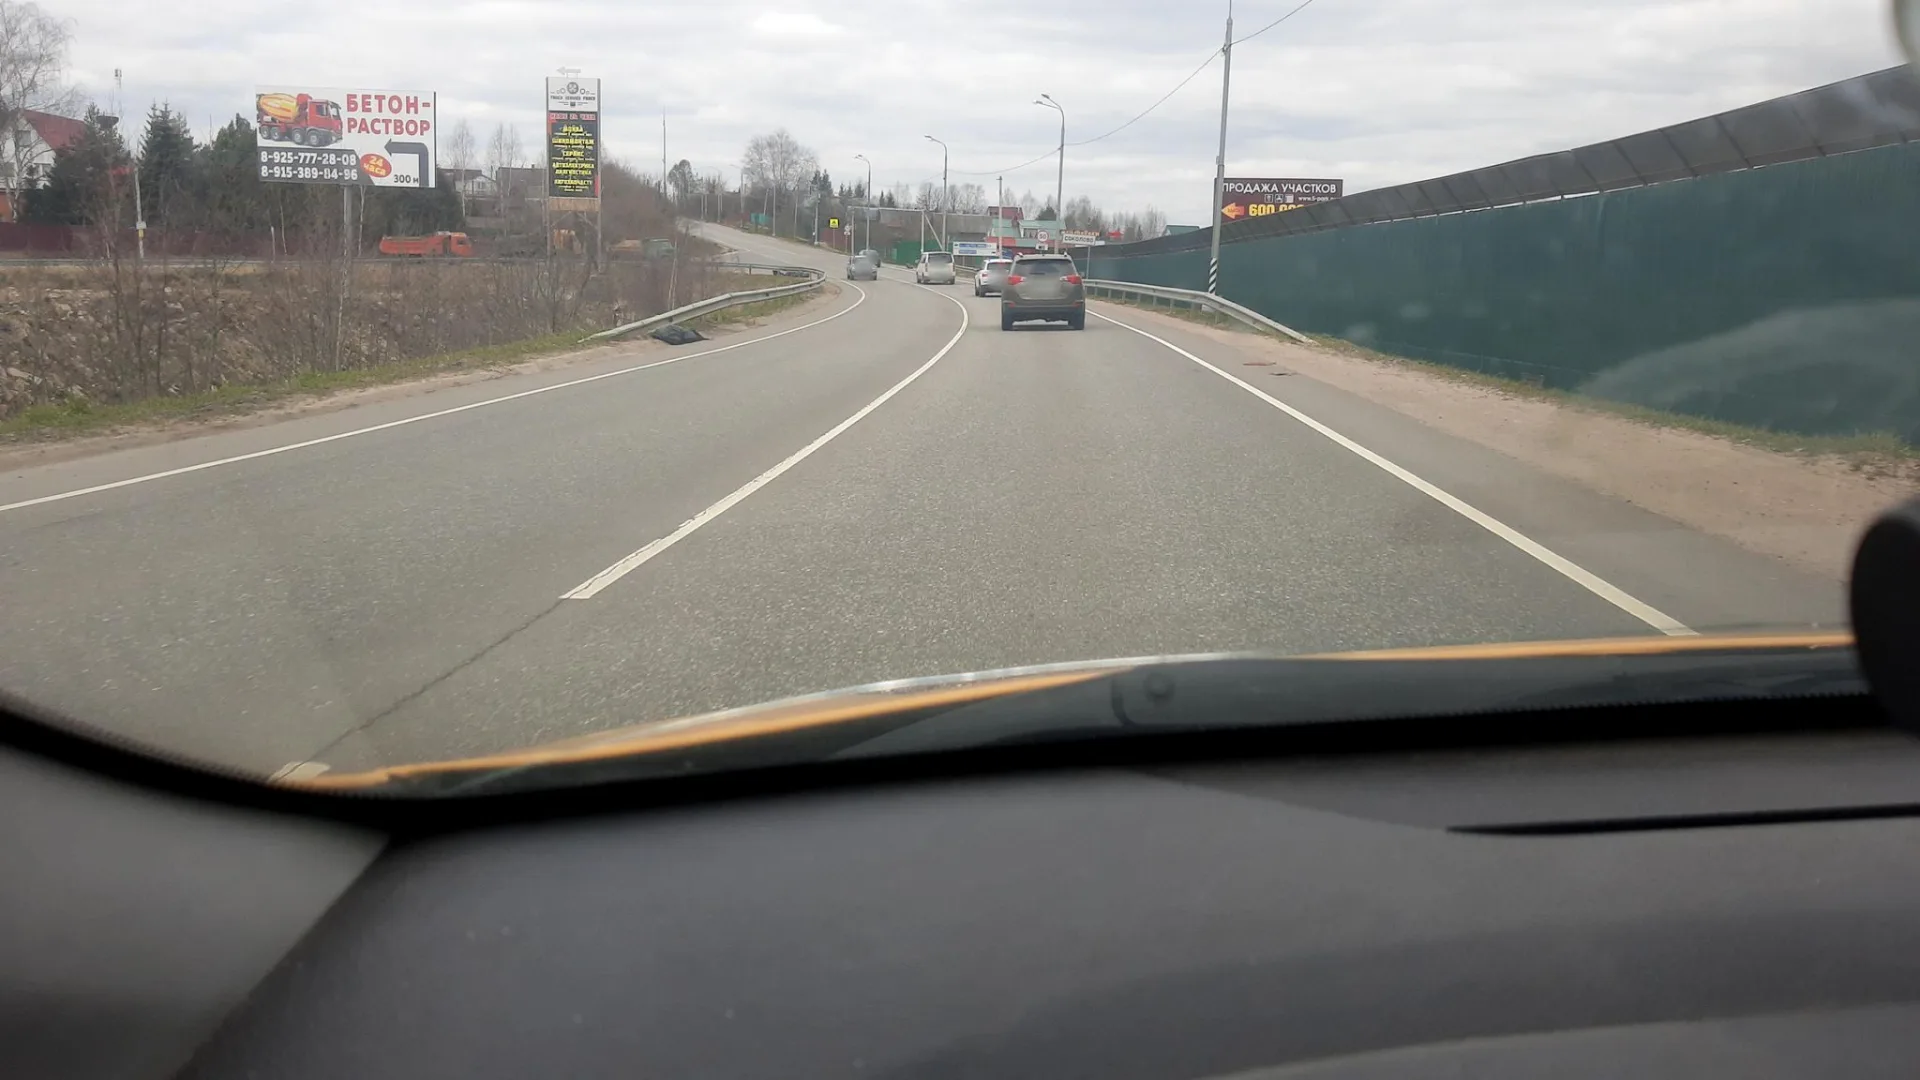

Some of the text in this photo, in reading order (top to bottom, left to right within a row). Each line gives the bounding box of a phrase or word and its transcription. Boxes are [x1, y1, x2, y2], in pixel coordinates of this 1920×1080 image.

[346, 93, 431, 115] БЕТОН-
[346, 117, 431, 136] РАСТВОР
[260, 151, 357, 166] 8-925-777-28-08
[369, 156, 384, 167] 24
[393, 174, 411, 184] 300
[1222, 183, 1337, 194] ПРОДАЖА УЧАСТКОВ
[1248, 204, 1275, 217] 600
